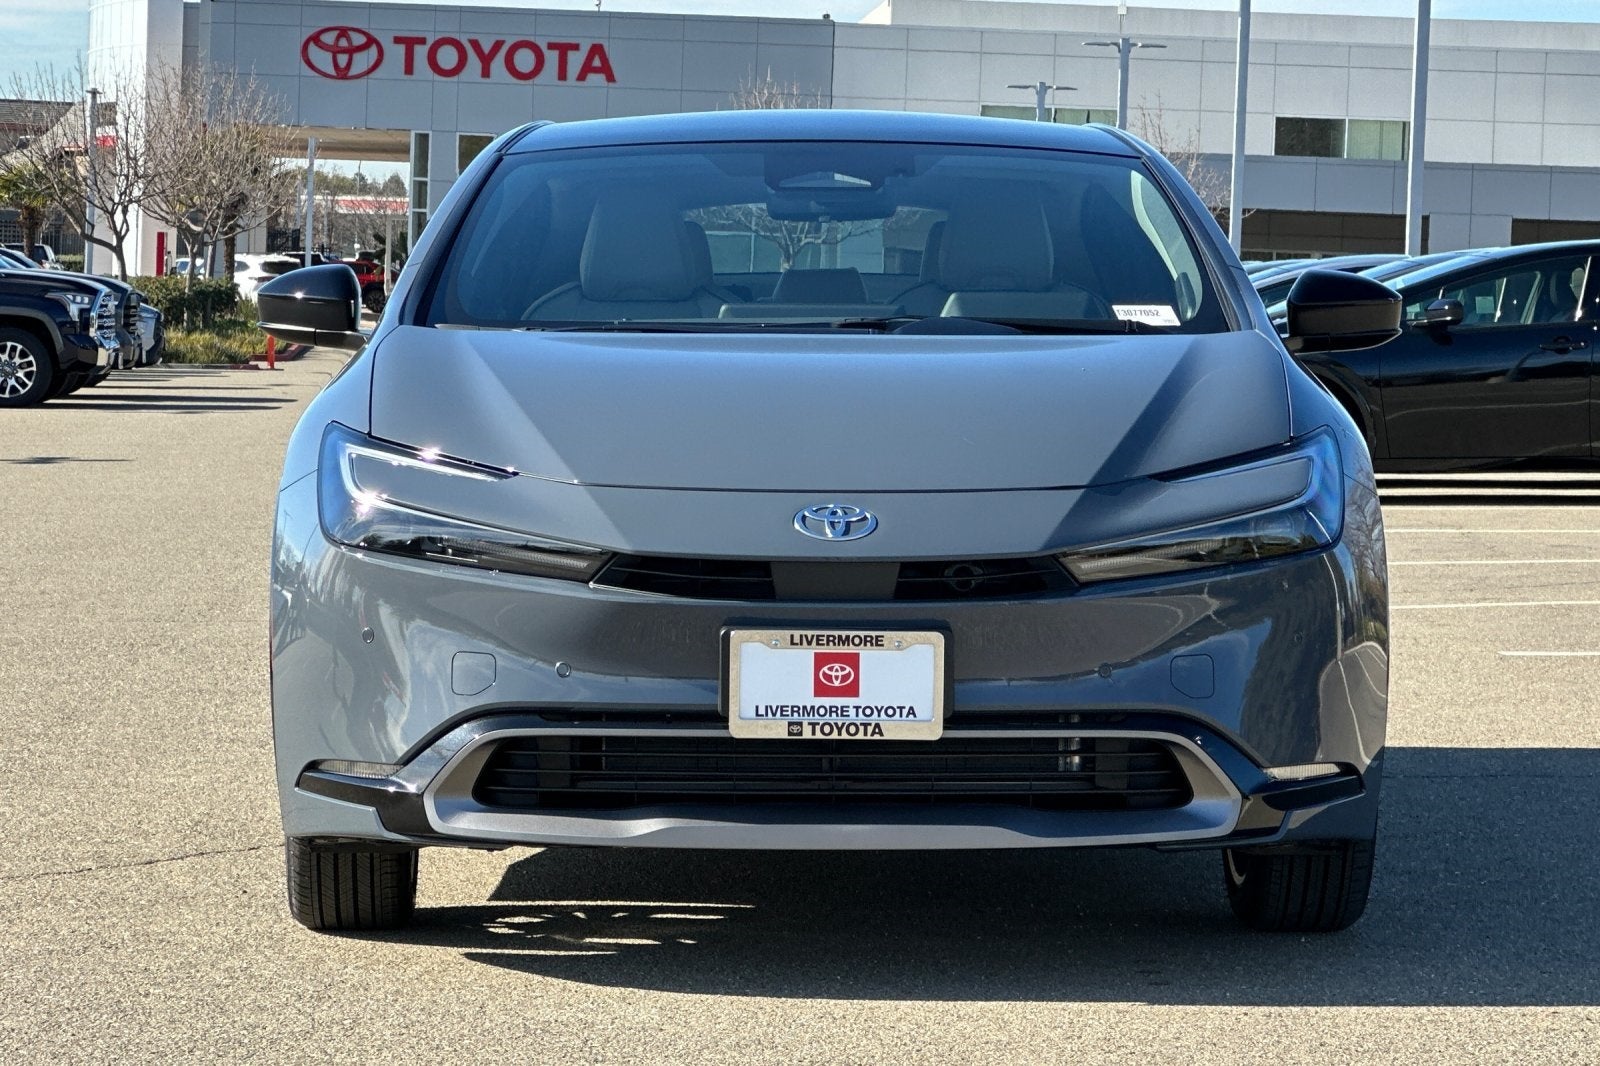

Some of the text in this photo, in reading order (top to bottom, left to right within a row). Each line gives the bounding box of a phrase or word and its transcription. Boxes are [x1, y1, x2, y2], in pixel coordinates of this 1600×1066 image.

[393, 36, 616, 83] TOYOTA
[790, 634, 884, 647] LIVERMORE
[755, 705, 917, 718] LIVERMORE TOYOTA
[808, 722, 884, 737] TOYOTA
